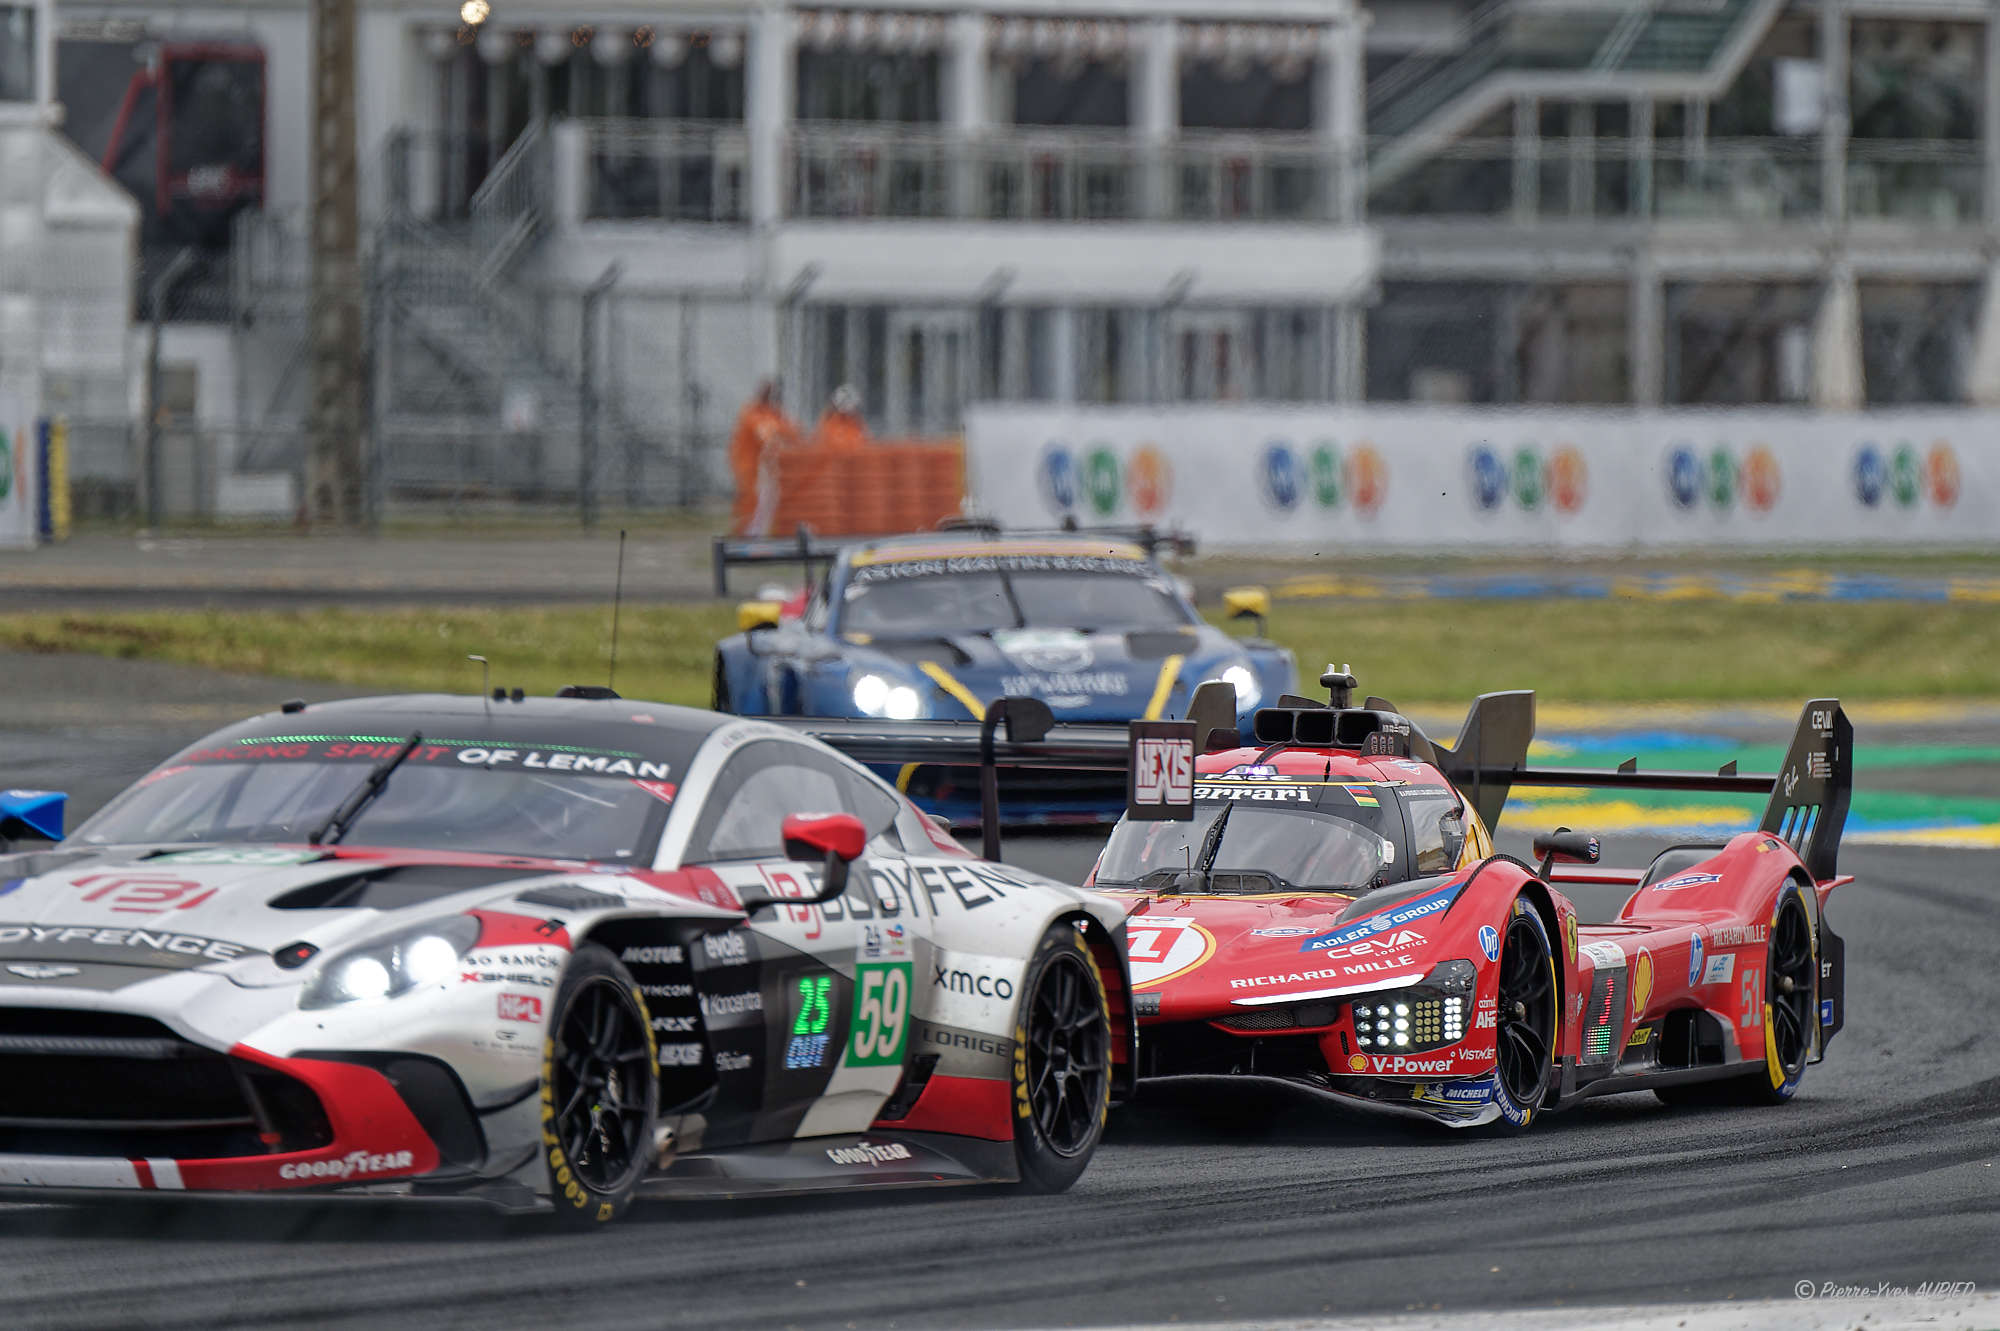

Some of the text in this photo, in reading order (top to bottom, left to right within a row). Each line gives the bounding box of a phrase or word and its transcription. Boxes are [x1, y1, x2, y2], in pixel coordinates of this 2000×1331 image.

[457, 748, 518, 764] OF
[523, 752, 671, 779] LEMAN
[1136, 738, 1194, 805] HEXIS
[1193, 784, 1314, 802] errari
[1311, 926, 1372, 949] ADLER
[1392, 898, 1450, 923] GROUP
[1712, 925, 1766, 947] RICHARD MILLE
[621, 946, 684, 963] MOTUL
[1375, 939, 1429, 957] LOGISTICS
[1481, 927, 1499, 961] hp
[933, 964, 1013, 1000] xmco
[1230, 954, 1416, 989] RICHARD MILLE
[793, 976, 831, 1035] 25
[854, 967, 908, 1059] 59
[1741, 968, 1761, 1028] 51
[1372, 1055, 1454, 1073] V-Power
[1446, 1088, 1491, 1099] MICHELIN
[279, 1150, 413, 1180] GOODYEAR
[826, 1142, 912, 1168] GOODYEAR
